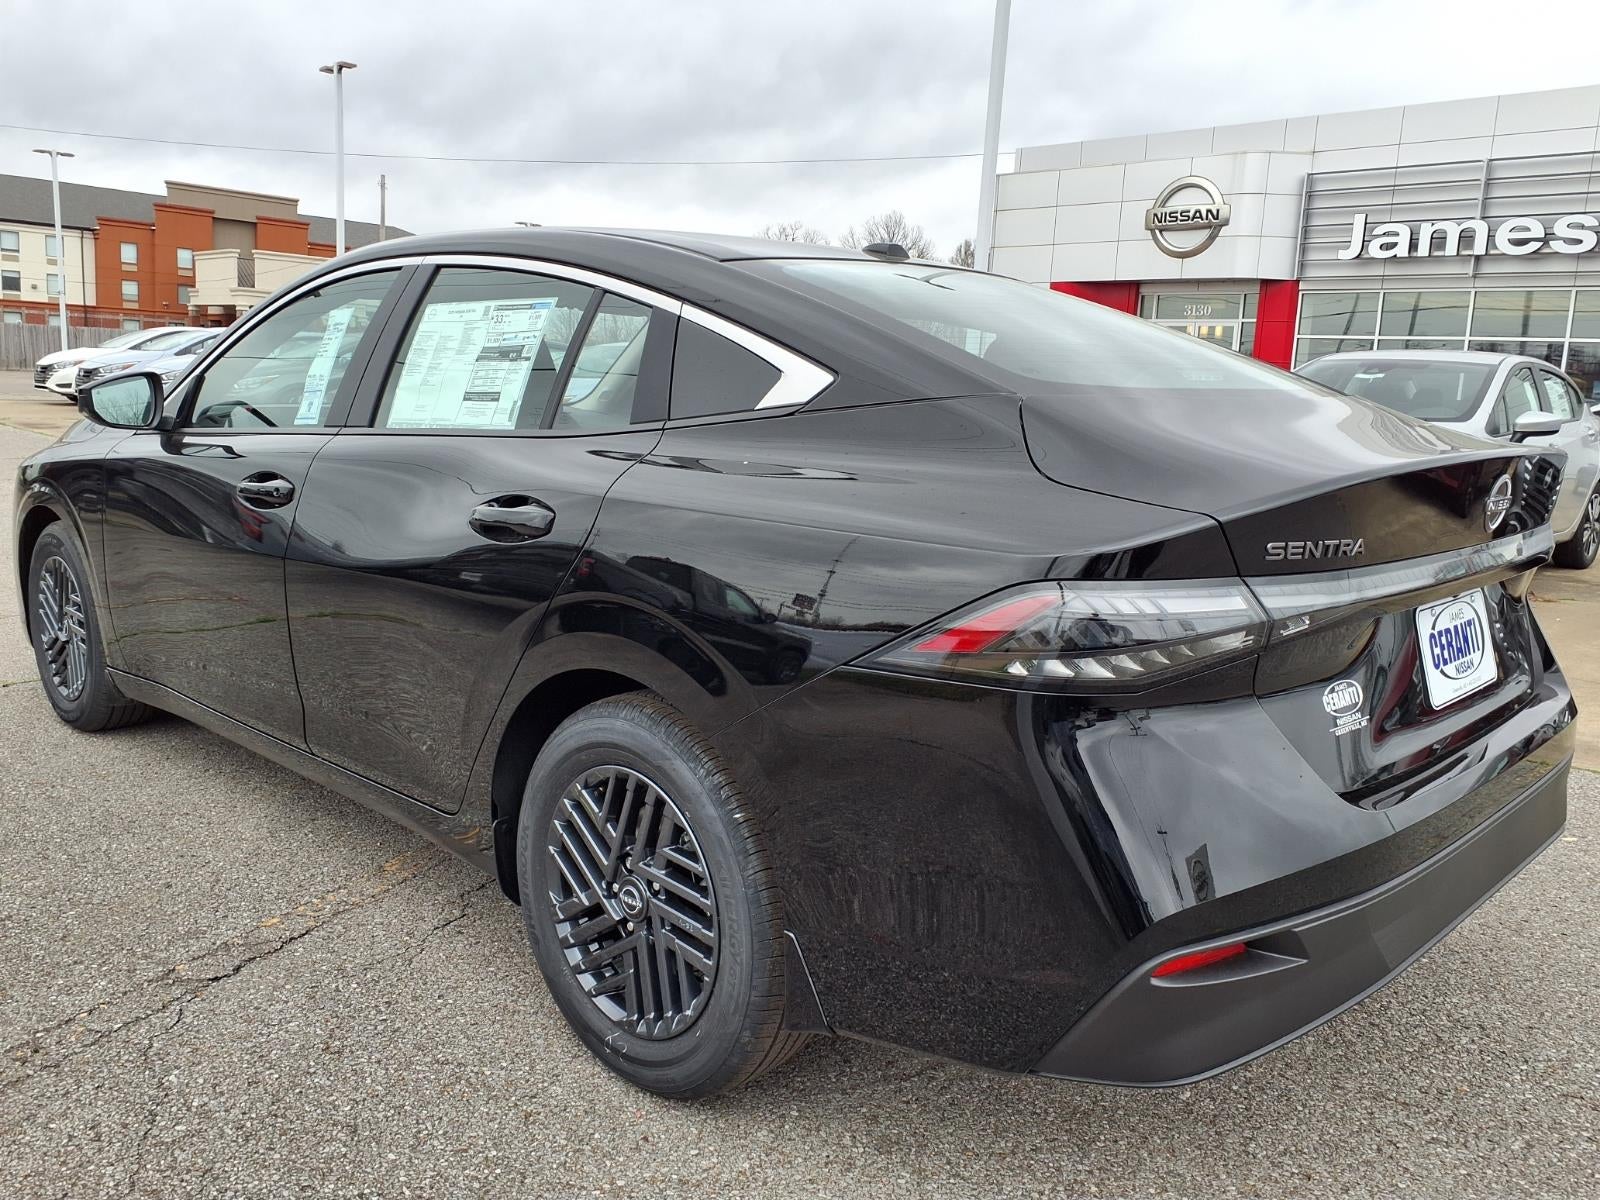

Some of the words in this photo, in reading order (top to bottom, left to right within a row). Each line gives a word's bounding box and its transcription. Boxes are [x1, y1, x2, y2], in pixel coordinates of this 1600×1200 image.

[1152, 208, 1220, 225] NISSAN
[1337, 212, 1600, 261] James
[1183, 303, 1213, 316] 3130
[1264, 538, 1365, 561] SENTRA
[1449, 607, 1465, 623] JAMES
[1428, 616, 1481, 671] CERANTI
[1454, 656, 1475, 676] NISSAN
[1322, 686, 1359, 712] CERANTI
[1336, 711, 1361, 726] NISSAN
